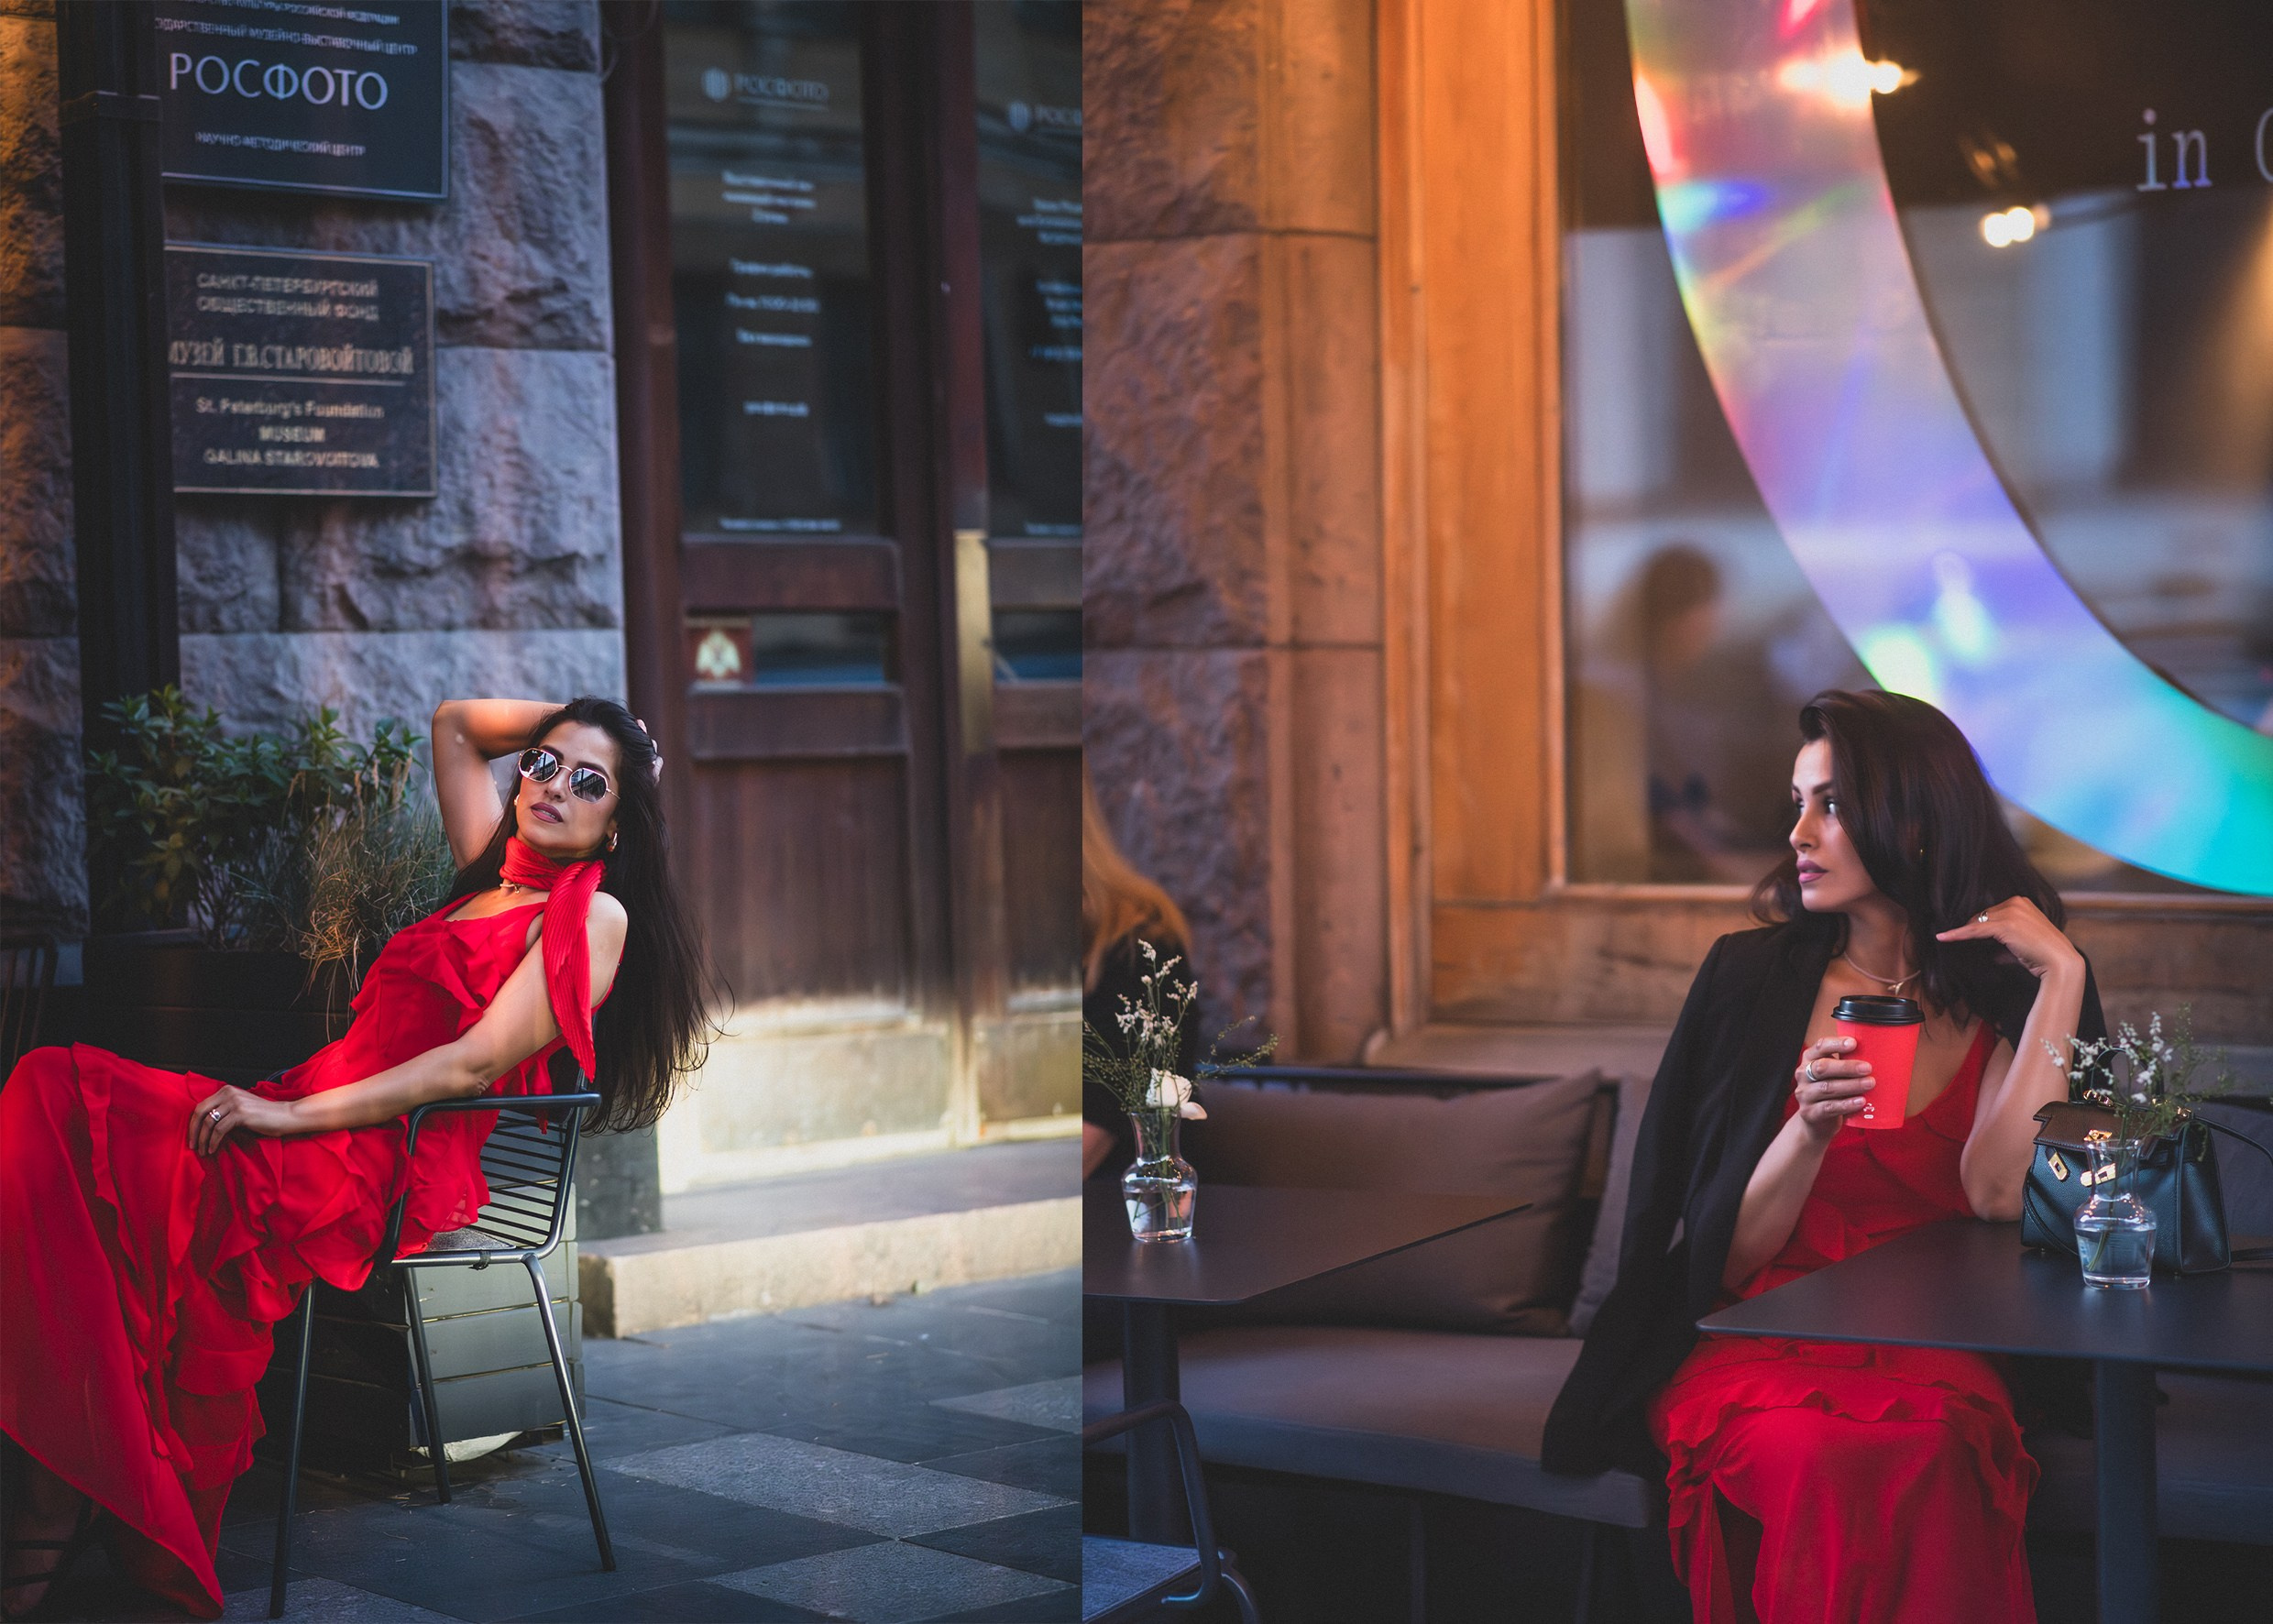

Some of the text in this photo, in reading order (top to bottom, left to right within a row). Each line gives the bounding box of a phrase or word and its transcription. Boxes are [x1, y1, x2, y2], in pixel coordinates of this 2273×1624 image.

[170, 52, 389, 111] РОСФОТО
[2136, 108, 2213, 192] in
[195, 295, 380, 322] ОБЩЕСТВЕННЫЙ ФОНД
[258, 425, 326, 444] MUSEUM
[203, 447, 262, 466] GALINA
